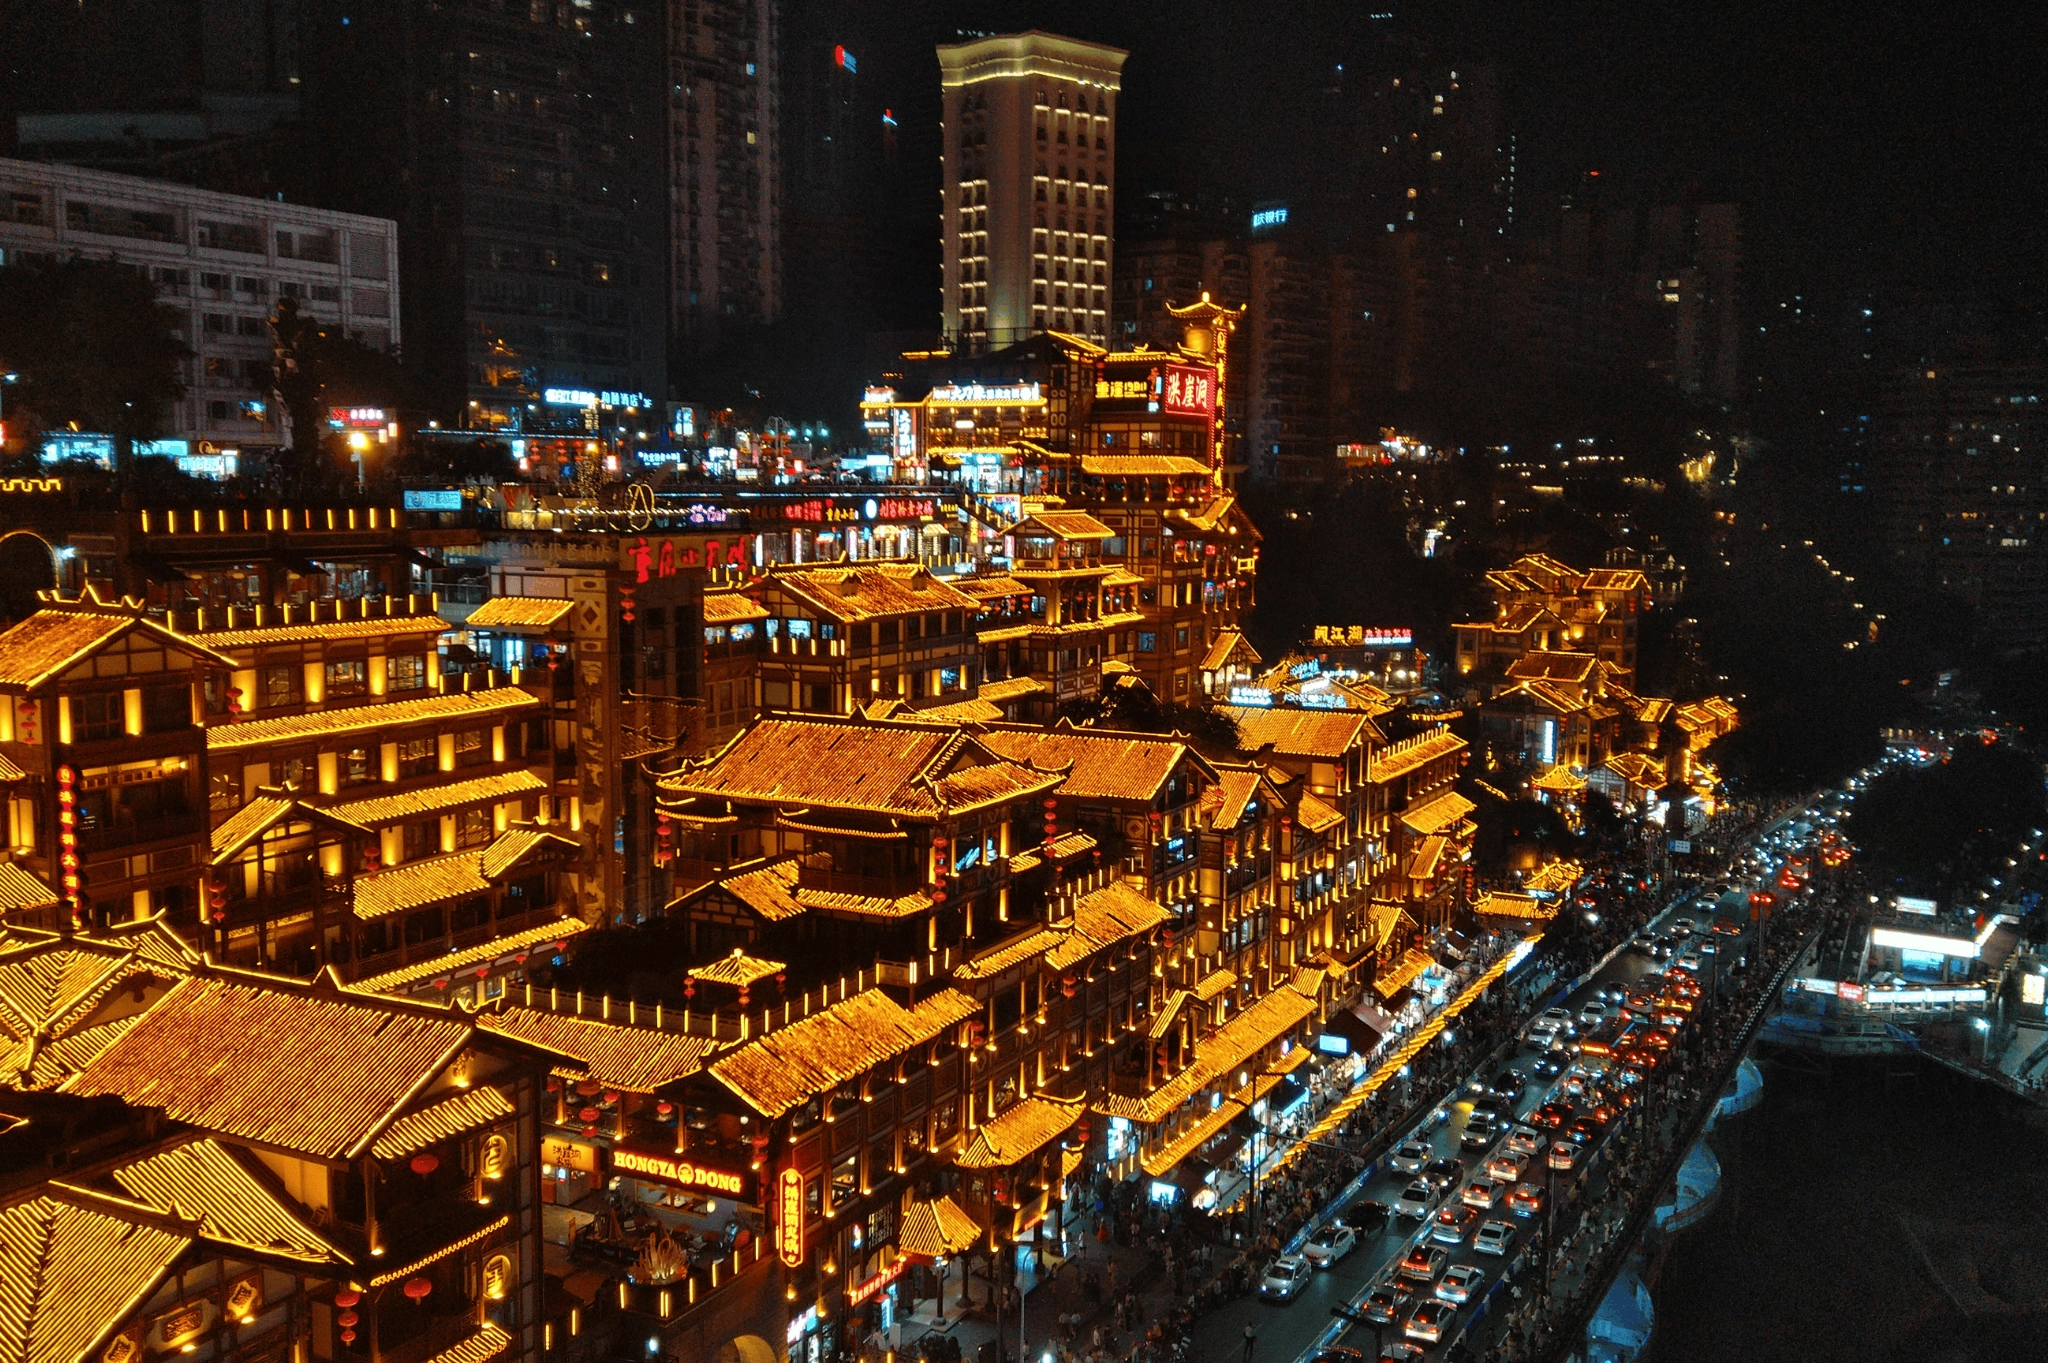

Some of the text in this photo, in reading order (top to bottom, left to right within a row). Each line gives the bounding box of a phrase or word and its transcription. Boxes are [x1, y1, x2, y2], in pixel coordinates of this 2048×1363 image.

[1167, 371, 1208, 409] 洪崖洞
[613, 1151, 742, 1193] HONGYA DONG
[783, 1185, 799, 1254] 洪崖洞火锅
